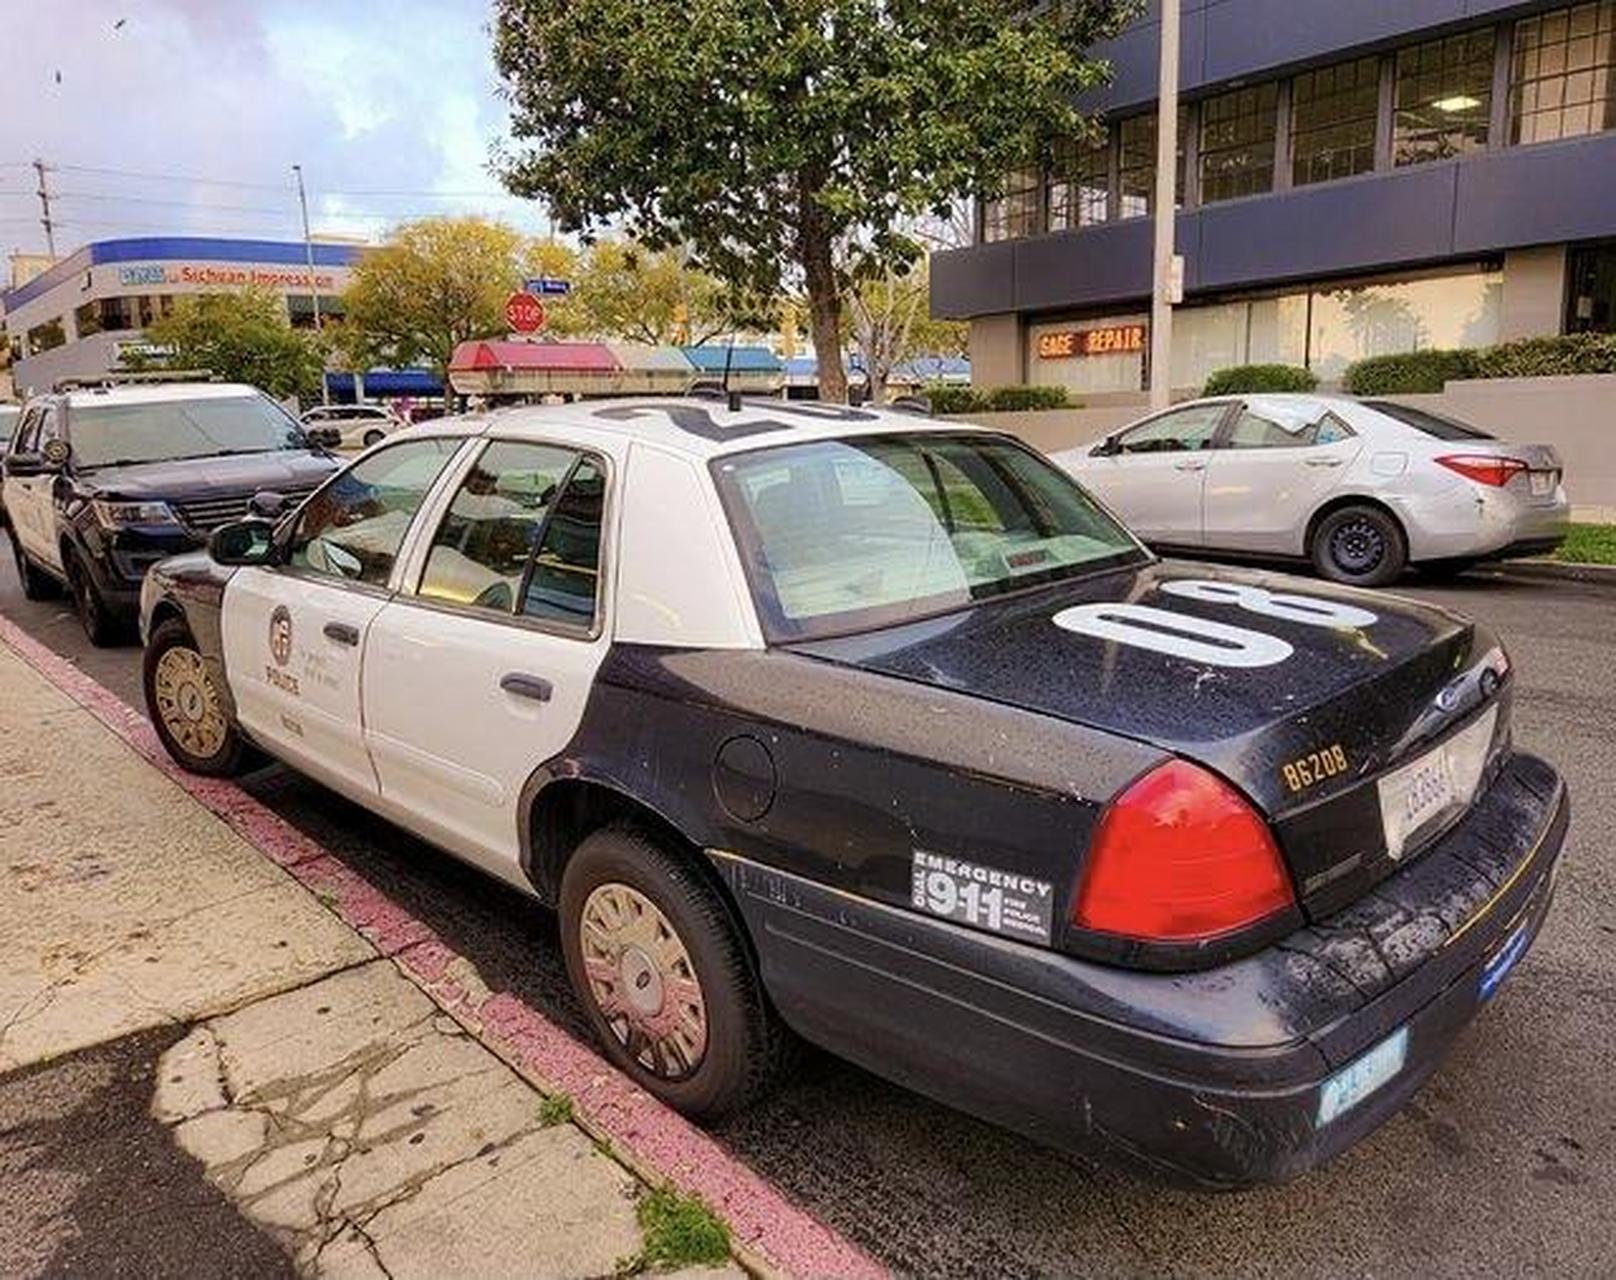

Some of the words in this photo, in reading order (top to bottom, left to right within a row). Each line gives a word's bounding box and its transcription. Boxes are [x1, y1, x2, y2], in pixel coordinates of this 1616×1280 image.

[182, 266, 247, 284] Sichuan
[251, 269, 333, 287] Impresson
[506, 304, 542, 322] STOP
[1087, 326, 1145, 352] REPAIR
[913, 851, 1052, 898] EMERGENCY
